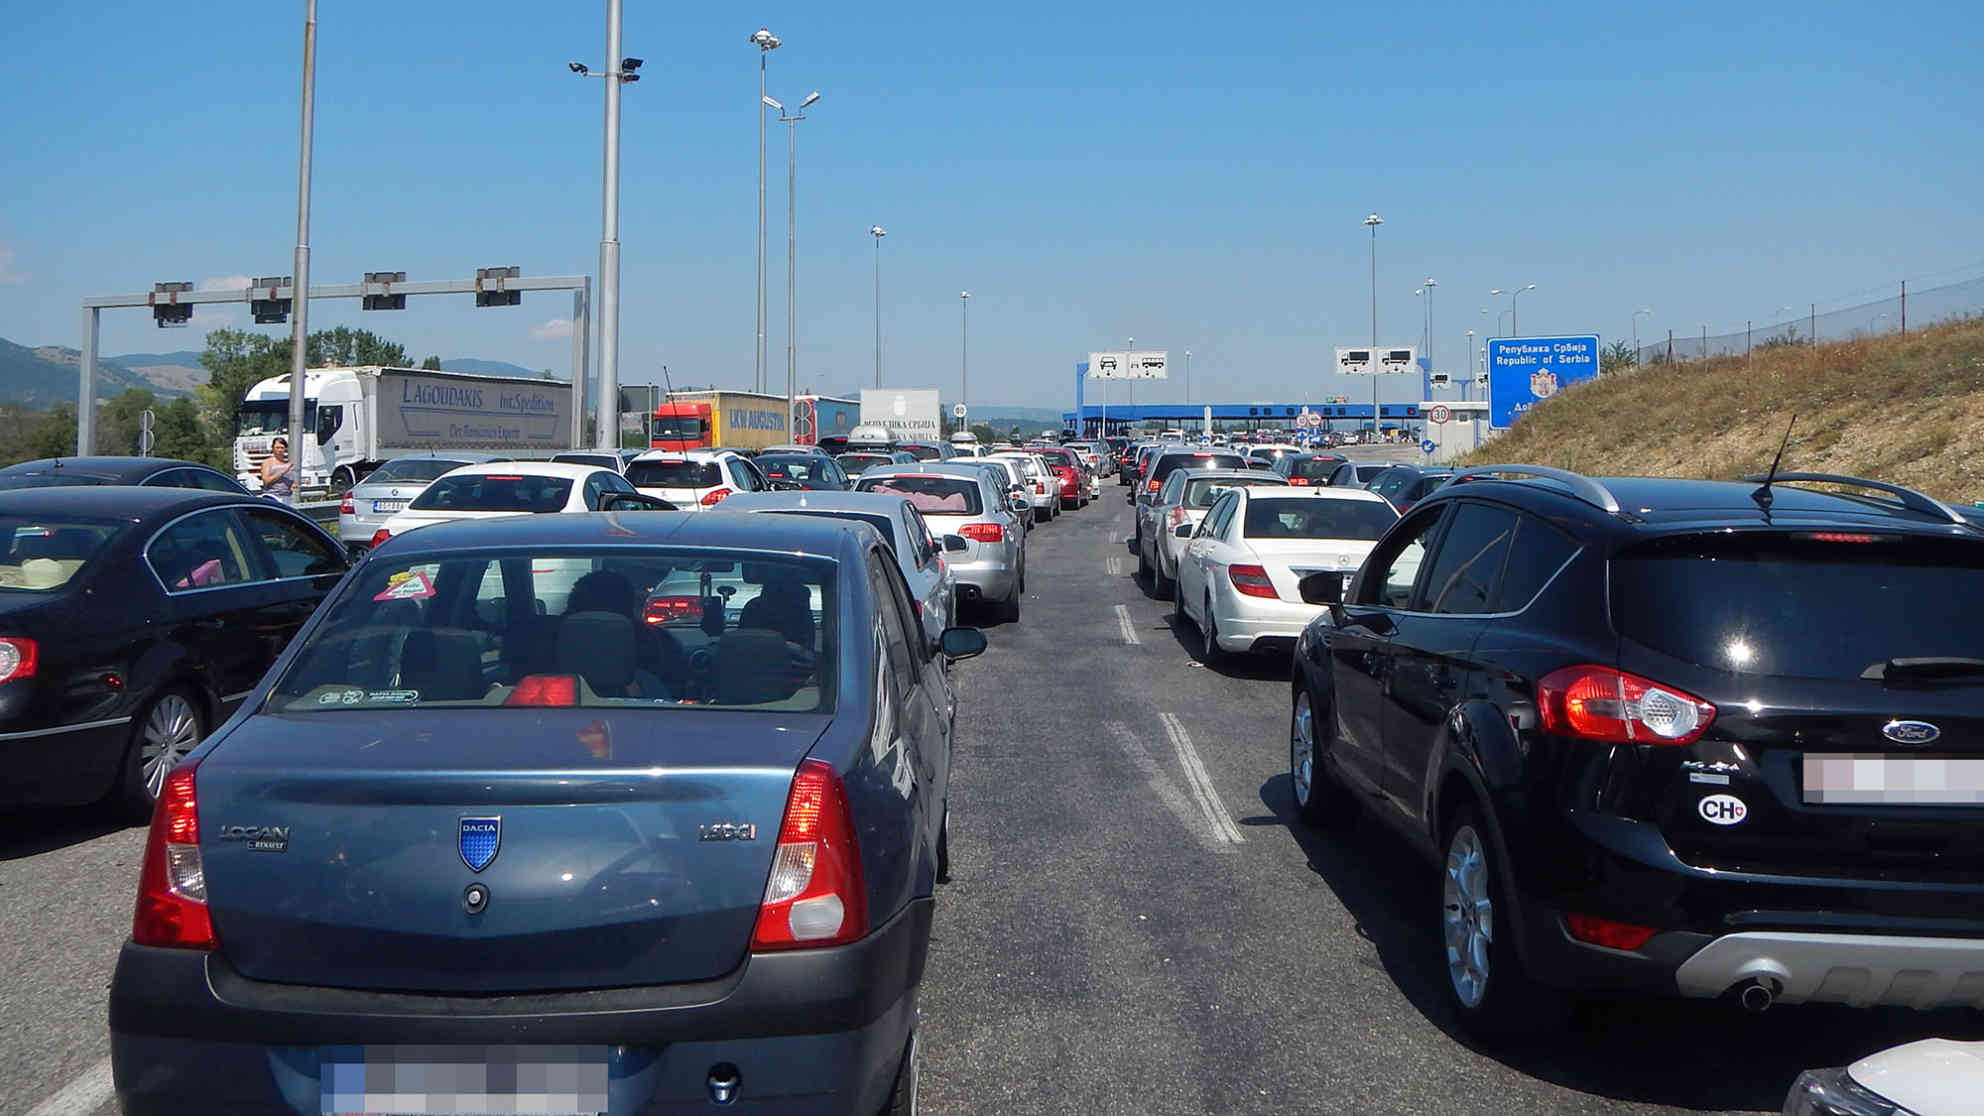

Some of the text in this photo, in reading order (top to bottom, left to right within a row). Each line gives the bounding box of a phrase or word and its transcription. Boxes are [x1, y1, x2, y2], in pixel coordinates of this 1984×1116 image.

[1499, 343, 1587, 355] Република Србија
[1496, 354, 1591, 366] Republic of Serbia
[1433, 408, 1447, 420] 30
[1896, 726, 1930, 738] Ford
[1702, 800, 1735, 819] CH
[219, 825, 289, 840] LOGAN
[463, 824, 496, 832] DACIA
